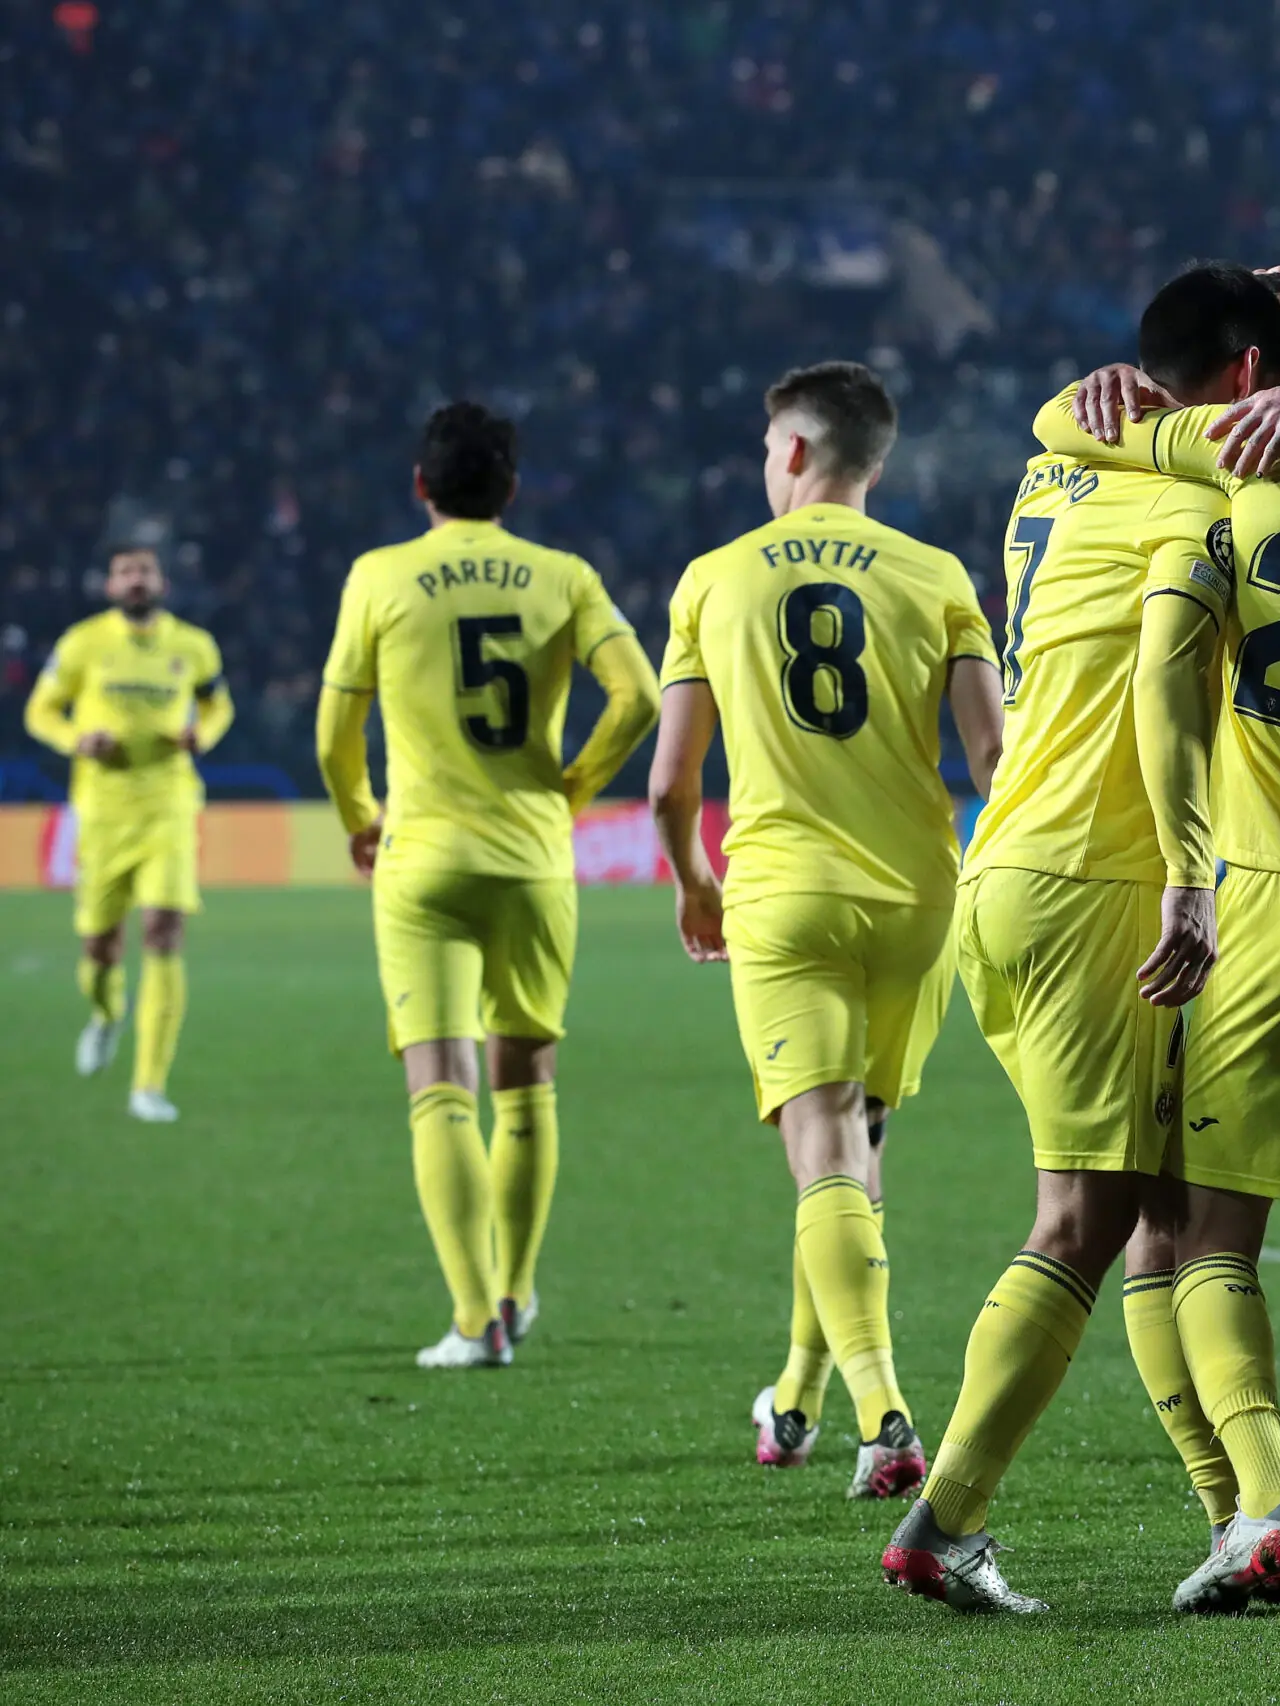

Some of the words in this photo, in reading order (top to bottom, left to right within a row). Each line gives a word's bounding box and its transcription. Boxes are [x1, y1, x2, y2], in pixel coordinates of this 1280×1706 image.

[417, 558, 532, 599] PAREJO
[760, 539, 878, 572] FOYTH
[1004, 516, 1056, 706] 7
[456, 613, 530, 753] 5
[777, 581, 870, 742] 8
